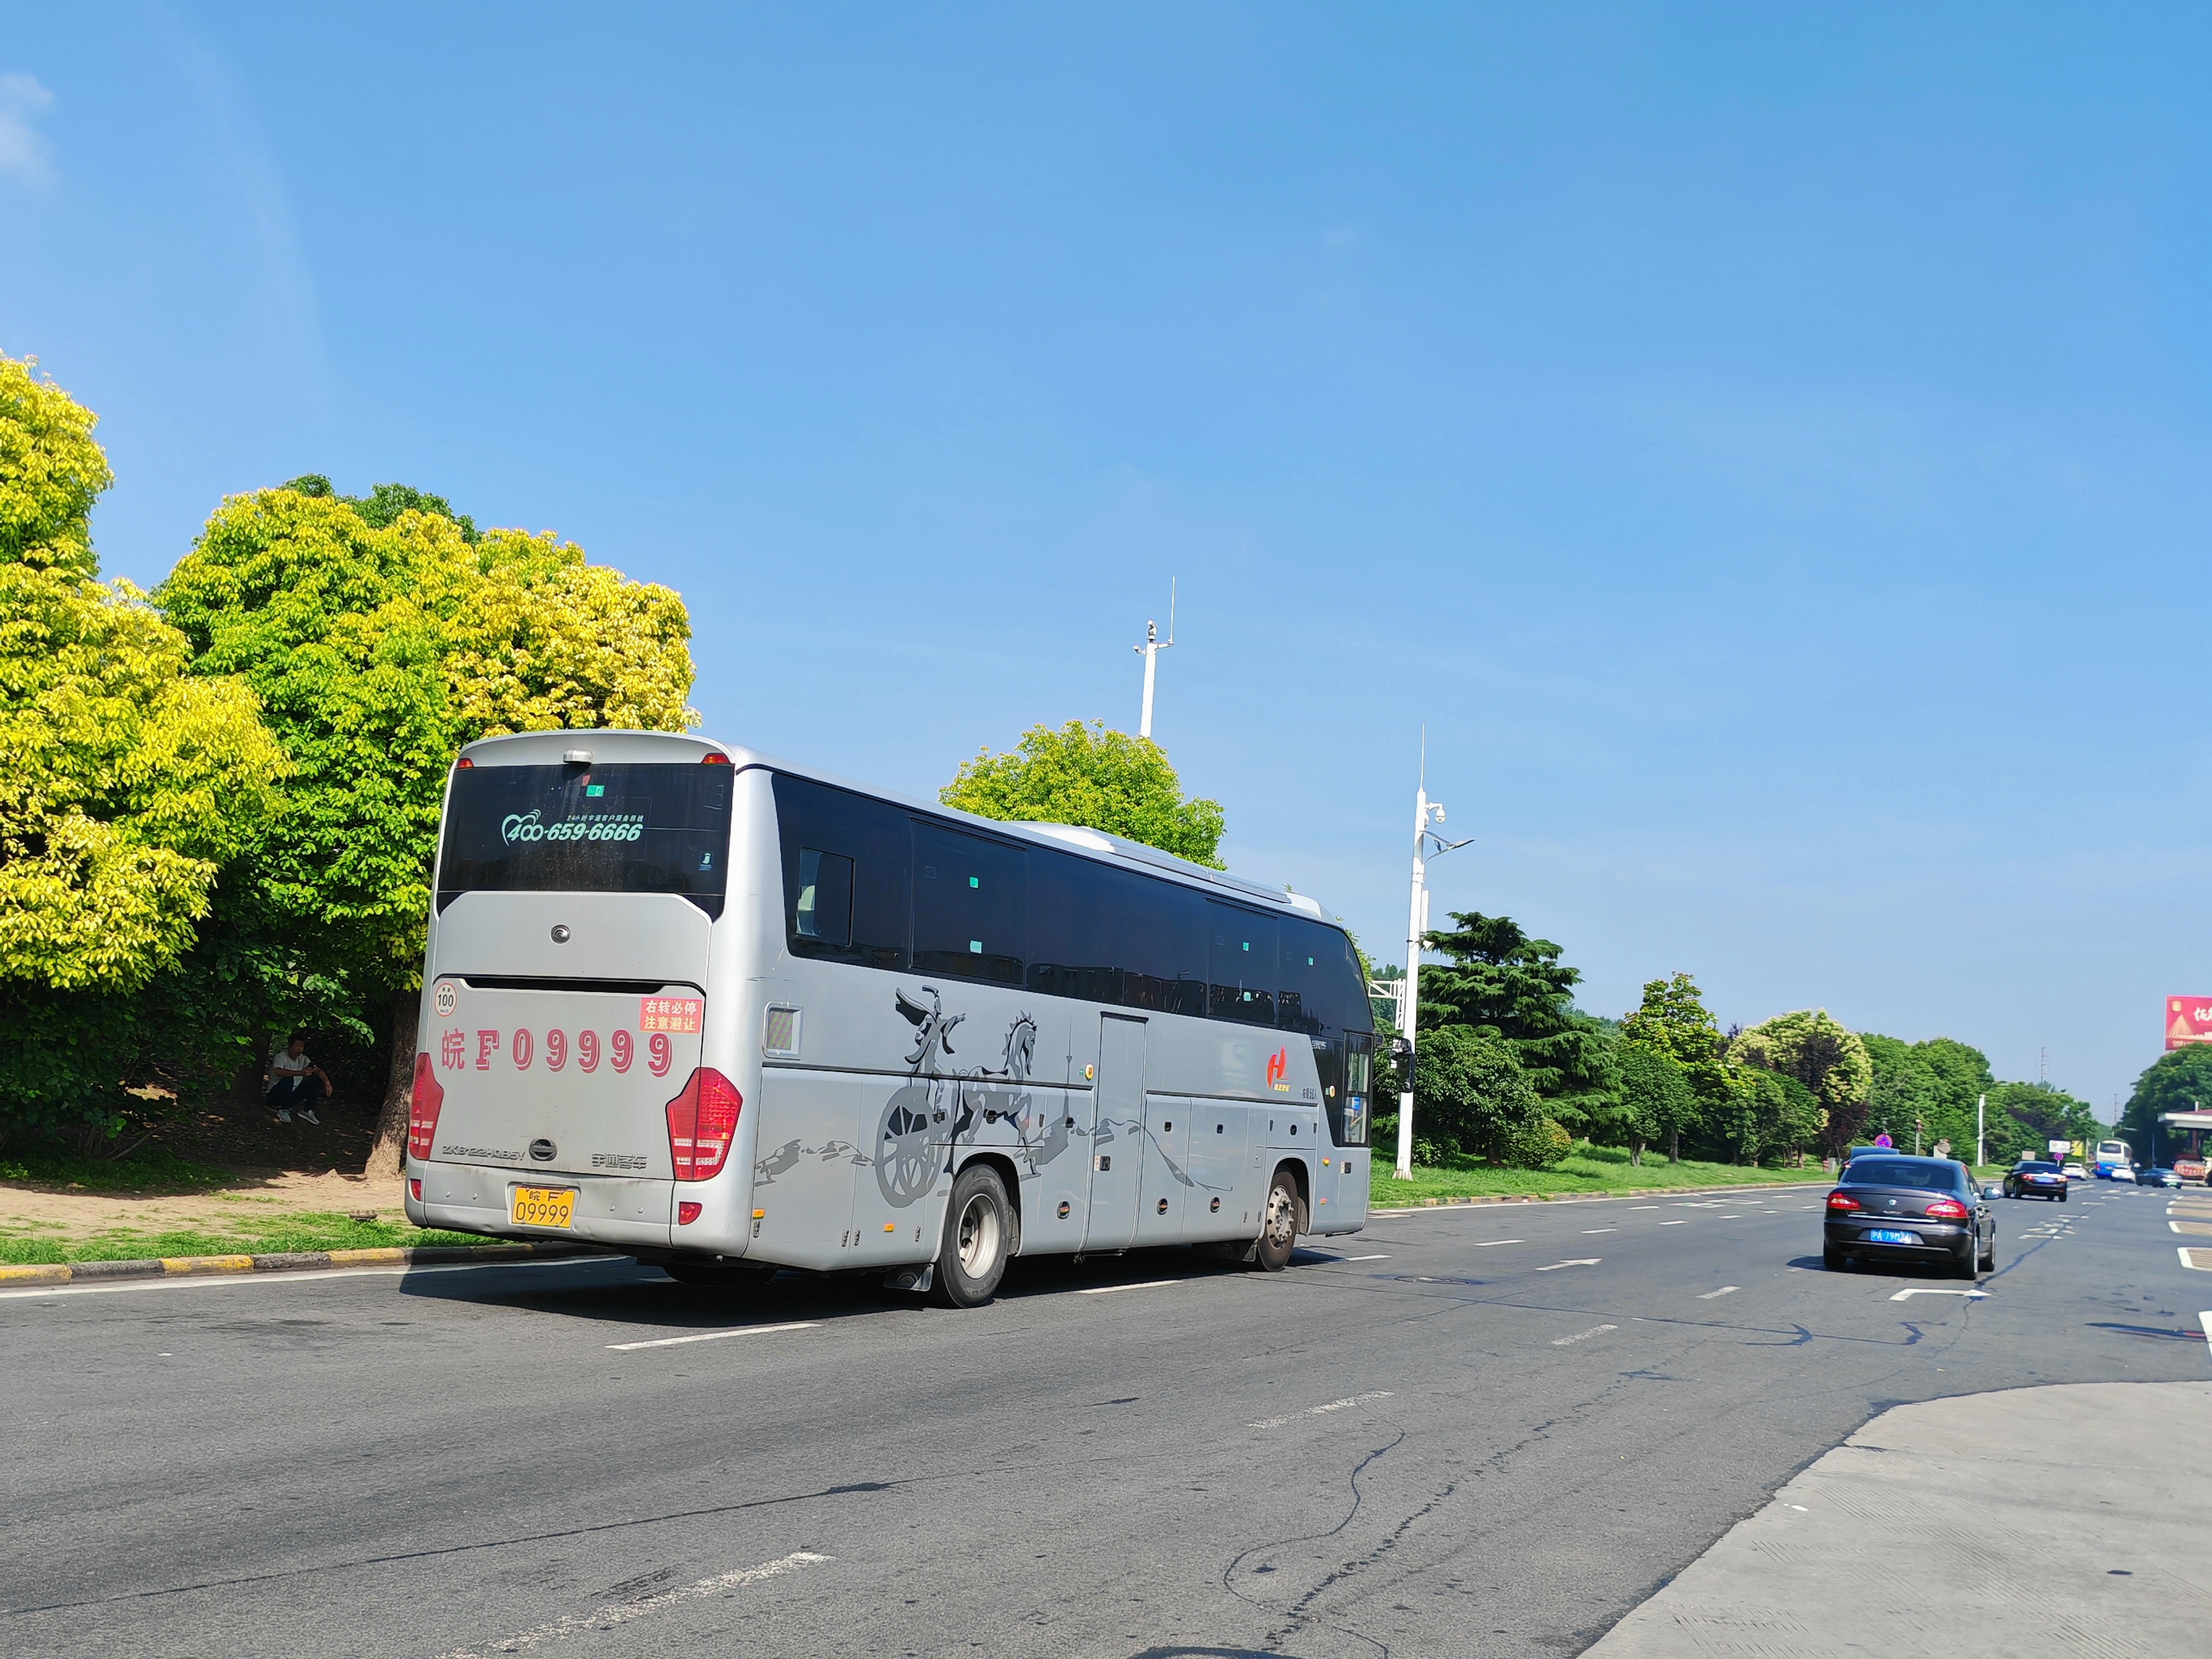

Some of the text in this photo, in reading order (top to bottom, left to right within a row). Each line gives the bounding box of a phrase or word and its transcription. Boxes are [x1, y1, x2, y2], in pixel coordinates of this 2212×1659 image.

[507, 823, 643, 841] 400-659-6666
[438, 994, 454, 1007] 100
[645, 999, 697, 1015] 右转必停
[644, 1015, 696, 1030] 注意避让
[591, 1153, 647, 1170] 宇通客车
[516, 1202, 569, 1224] 09999
